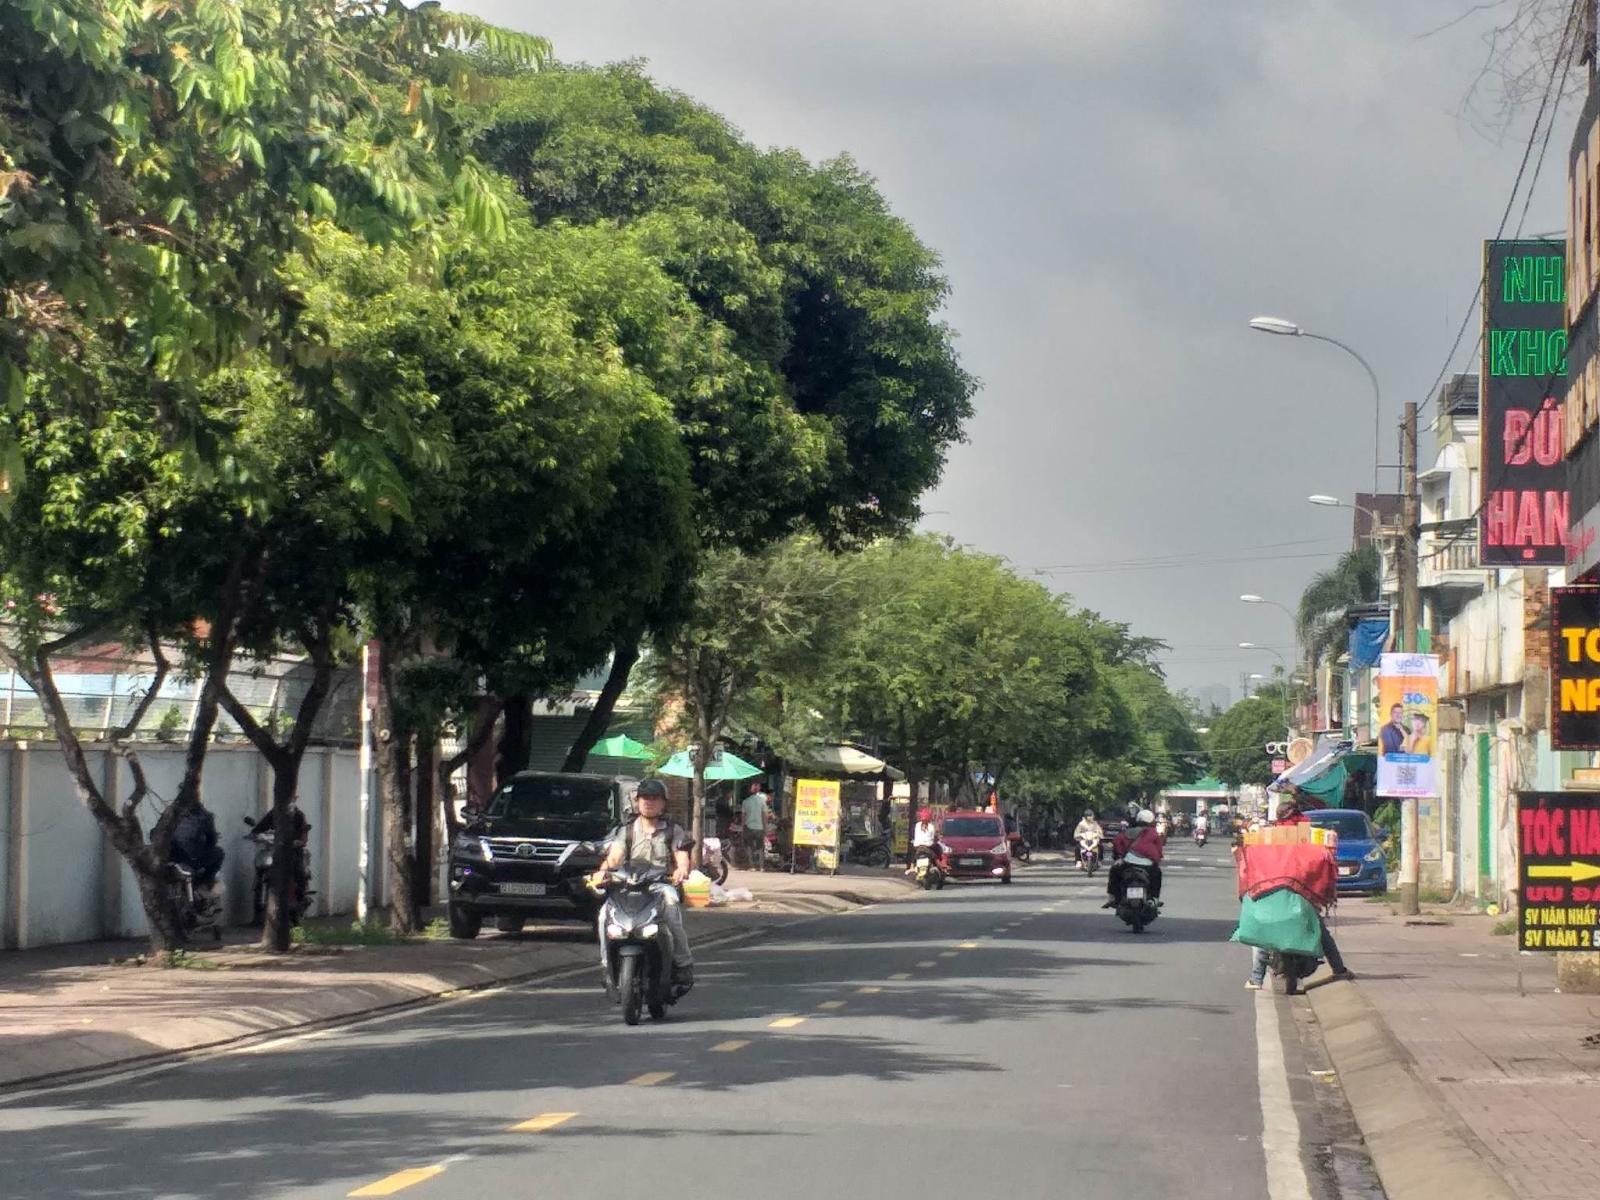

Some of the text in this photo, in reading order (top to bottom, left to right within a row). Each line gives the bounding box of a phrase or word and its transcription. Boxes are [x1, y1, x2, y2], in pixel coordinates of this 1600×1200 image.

[1504, 255, 1567, 303] NH
[1521, 798, 1564, 857] TÓC
[1525, 908, 1540, 925] SV
[1525, 929, 1543, 947] SV
[1581, 929, 1591, 947] 2
